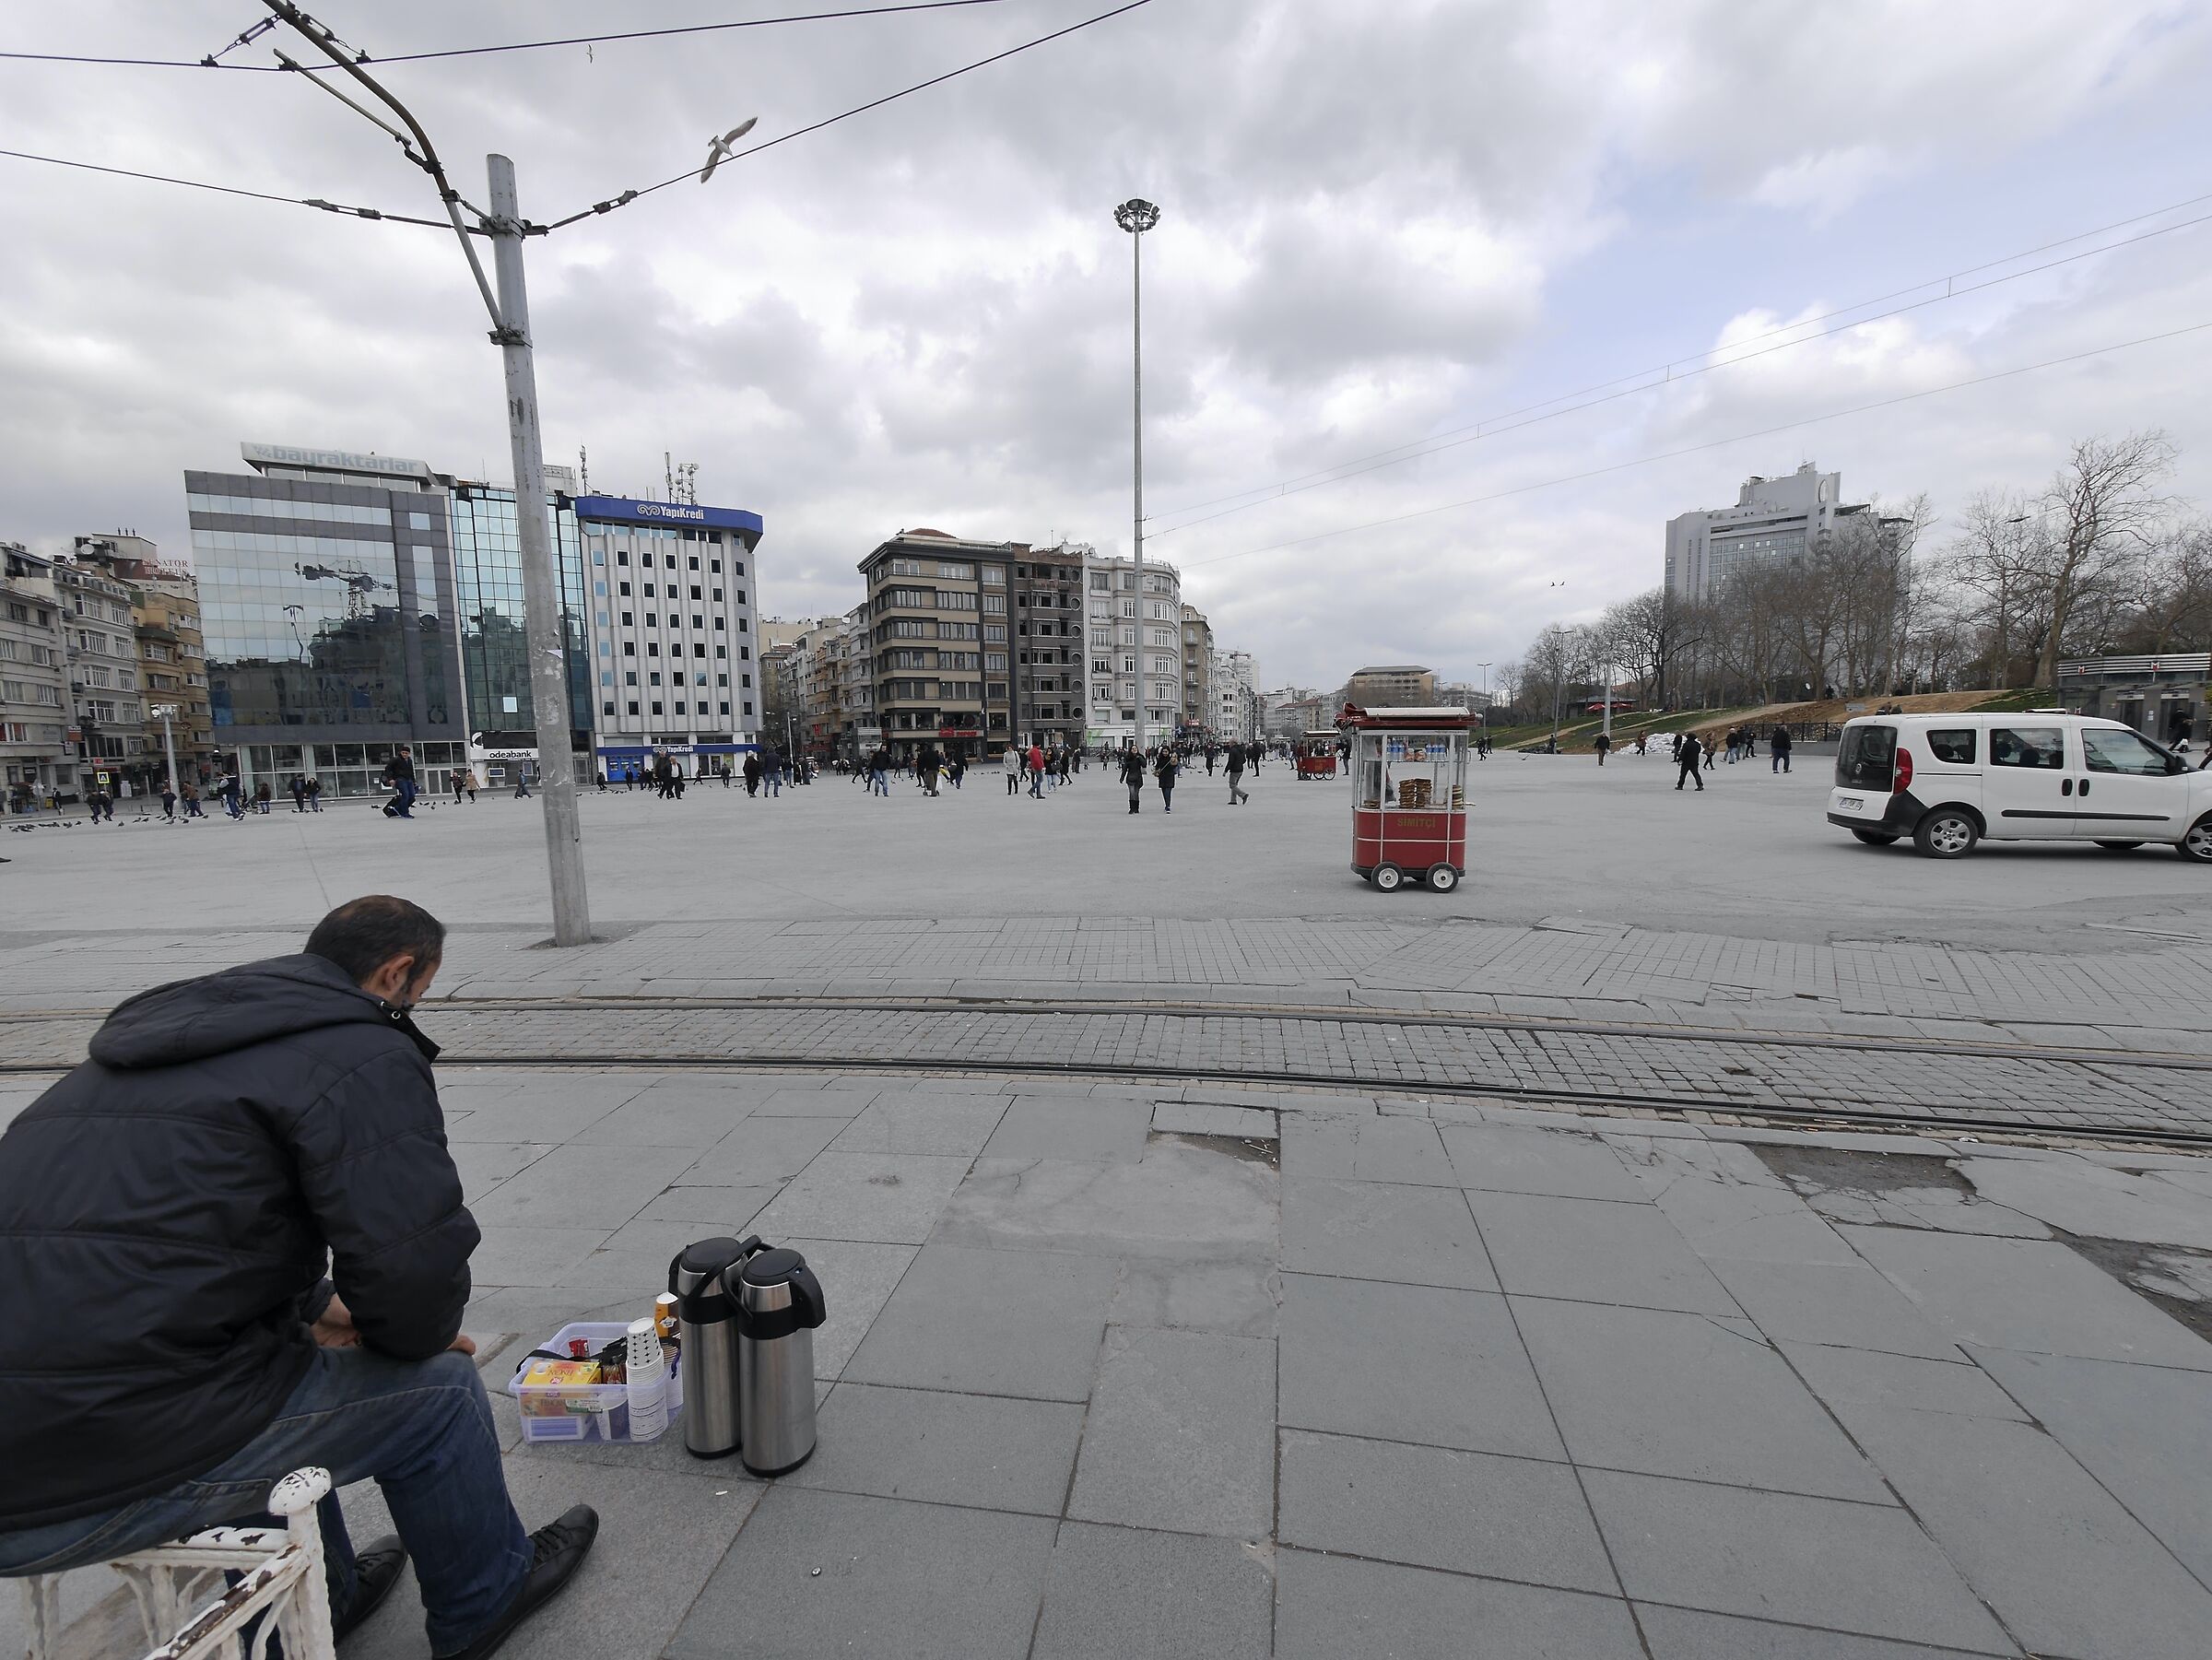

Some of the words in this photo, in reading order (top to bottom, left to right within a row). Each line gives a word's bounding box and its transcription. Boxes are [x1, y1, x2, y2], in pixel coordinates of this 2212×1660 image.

[273, 446, 418, 472] bayraktarlar
[660, 506, 704, 520] YapıKredi
[142, 559, 188, 568] SENATOR
[488, 749, 532, 759] odeabank
[666, 745, 694, 753] YapıKredi
[1396, 817, 1436, 828] SİMİTÇİ
